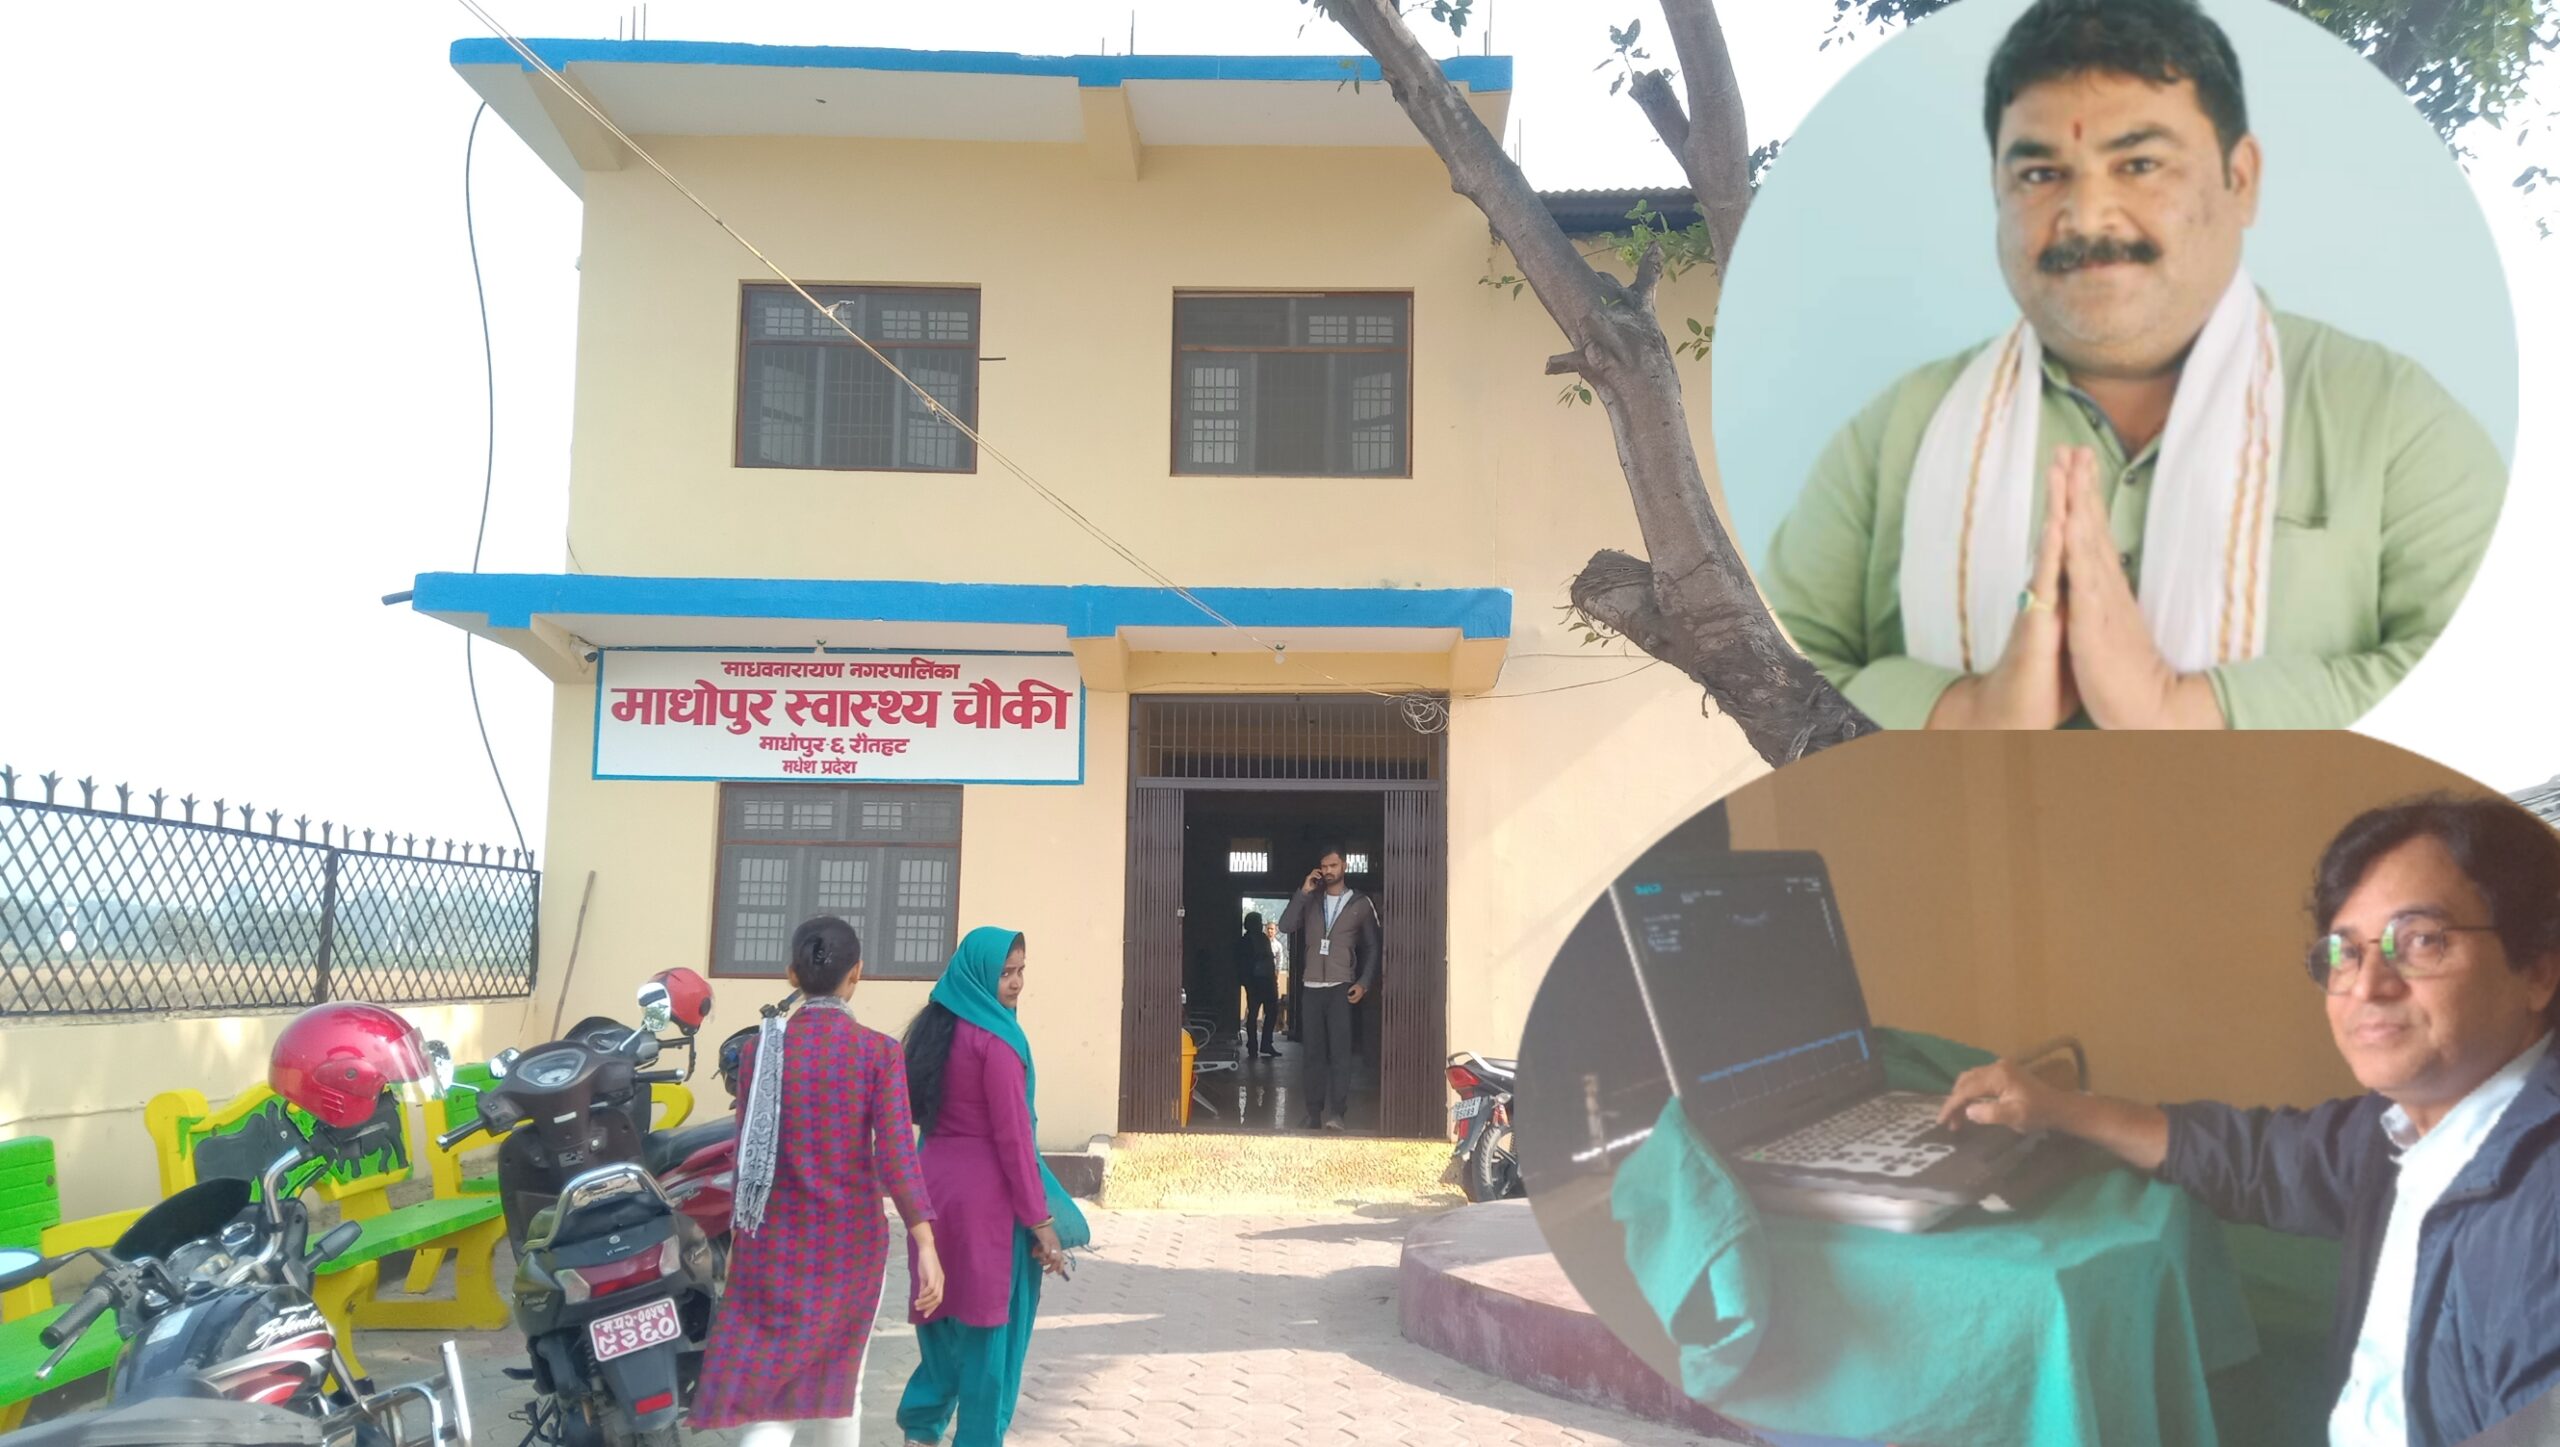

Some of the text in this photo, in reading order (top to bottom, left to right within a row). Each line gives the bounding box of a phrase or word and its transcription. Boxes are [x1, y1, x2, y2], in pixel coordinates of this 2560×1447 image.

[722, 656, 961, 681] माधवनारायण नगरपालिका
[611, 677, 1074, 736] माधोपुर स्वास्थ्य चौकी
[849, 732, 911, 757] रौतहट
[782, 757, 858, 775] मधेश प्रदेश
